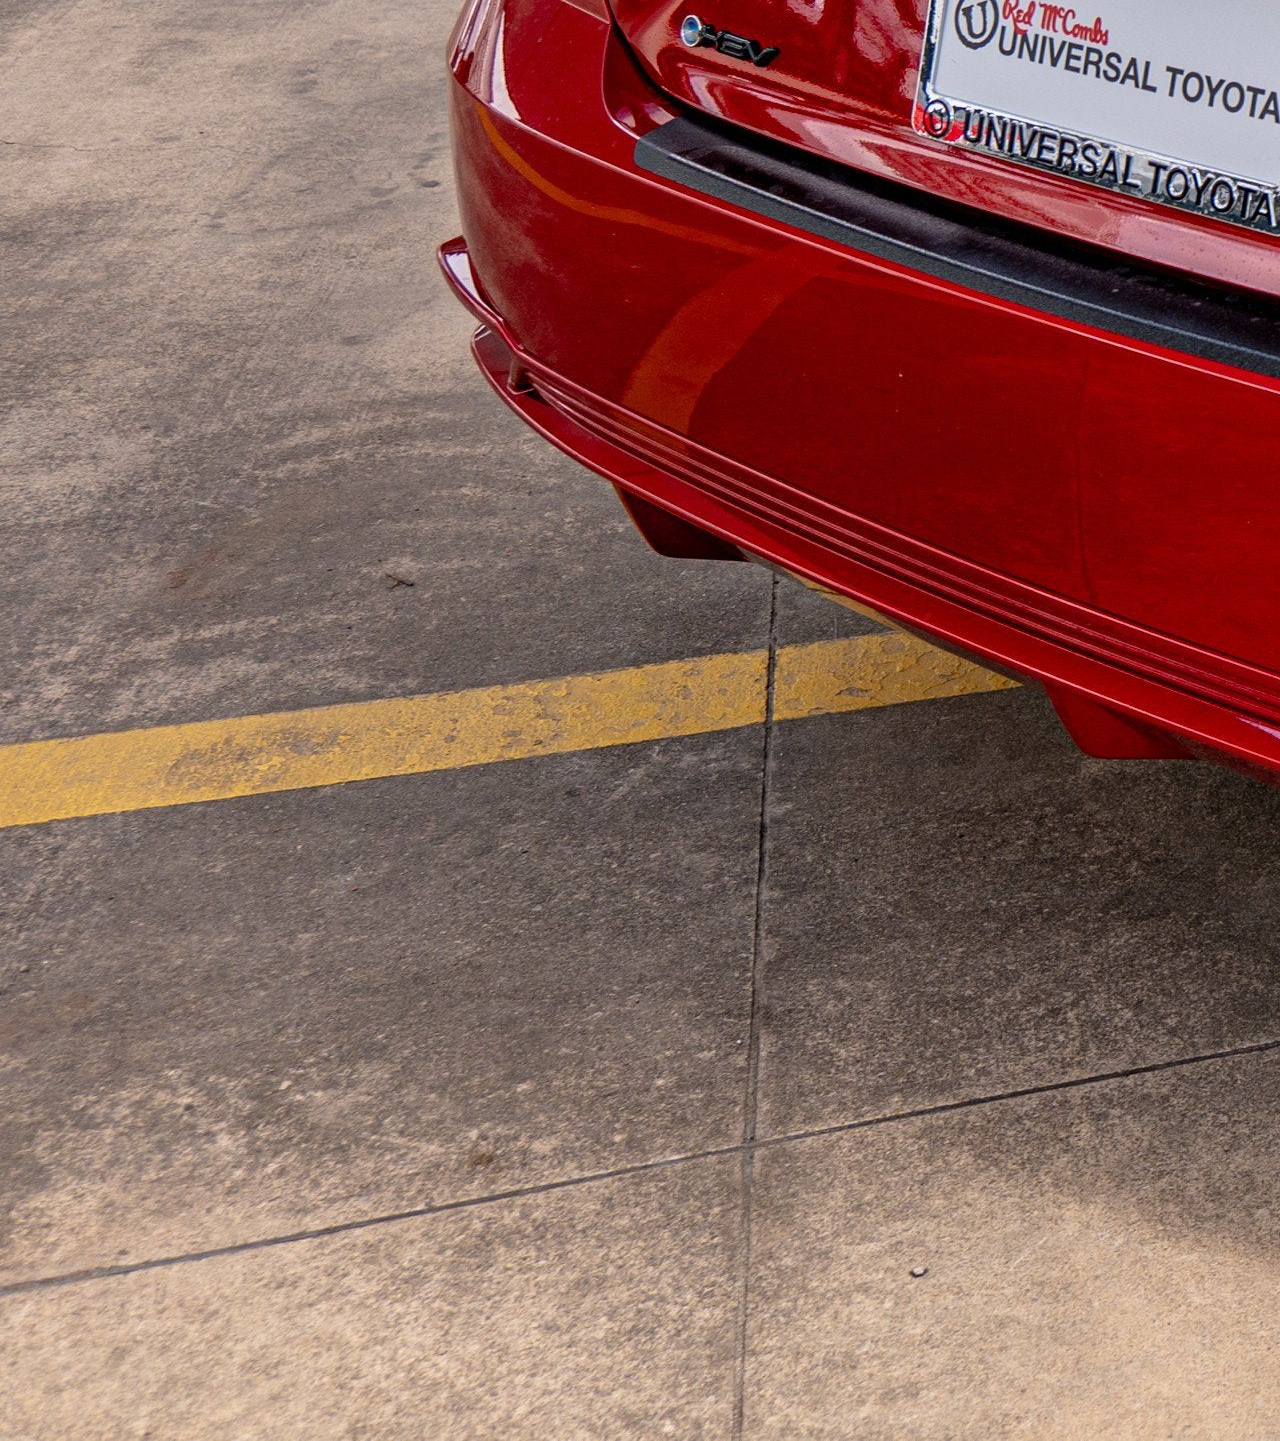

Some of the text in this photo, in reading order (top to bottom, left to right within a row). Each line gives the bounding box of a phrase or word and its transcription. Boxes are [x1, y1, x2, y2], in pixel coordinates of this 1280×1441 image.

[1039, 1, 1109, 46] McCombs
[999, 25, 1280, 124] UNIVERSAL TOYOTA
[963, 108, 1142, 189] UNIVERSAL
[1147, 159, 1278, 228] TOYOTA
